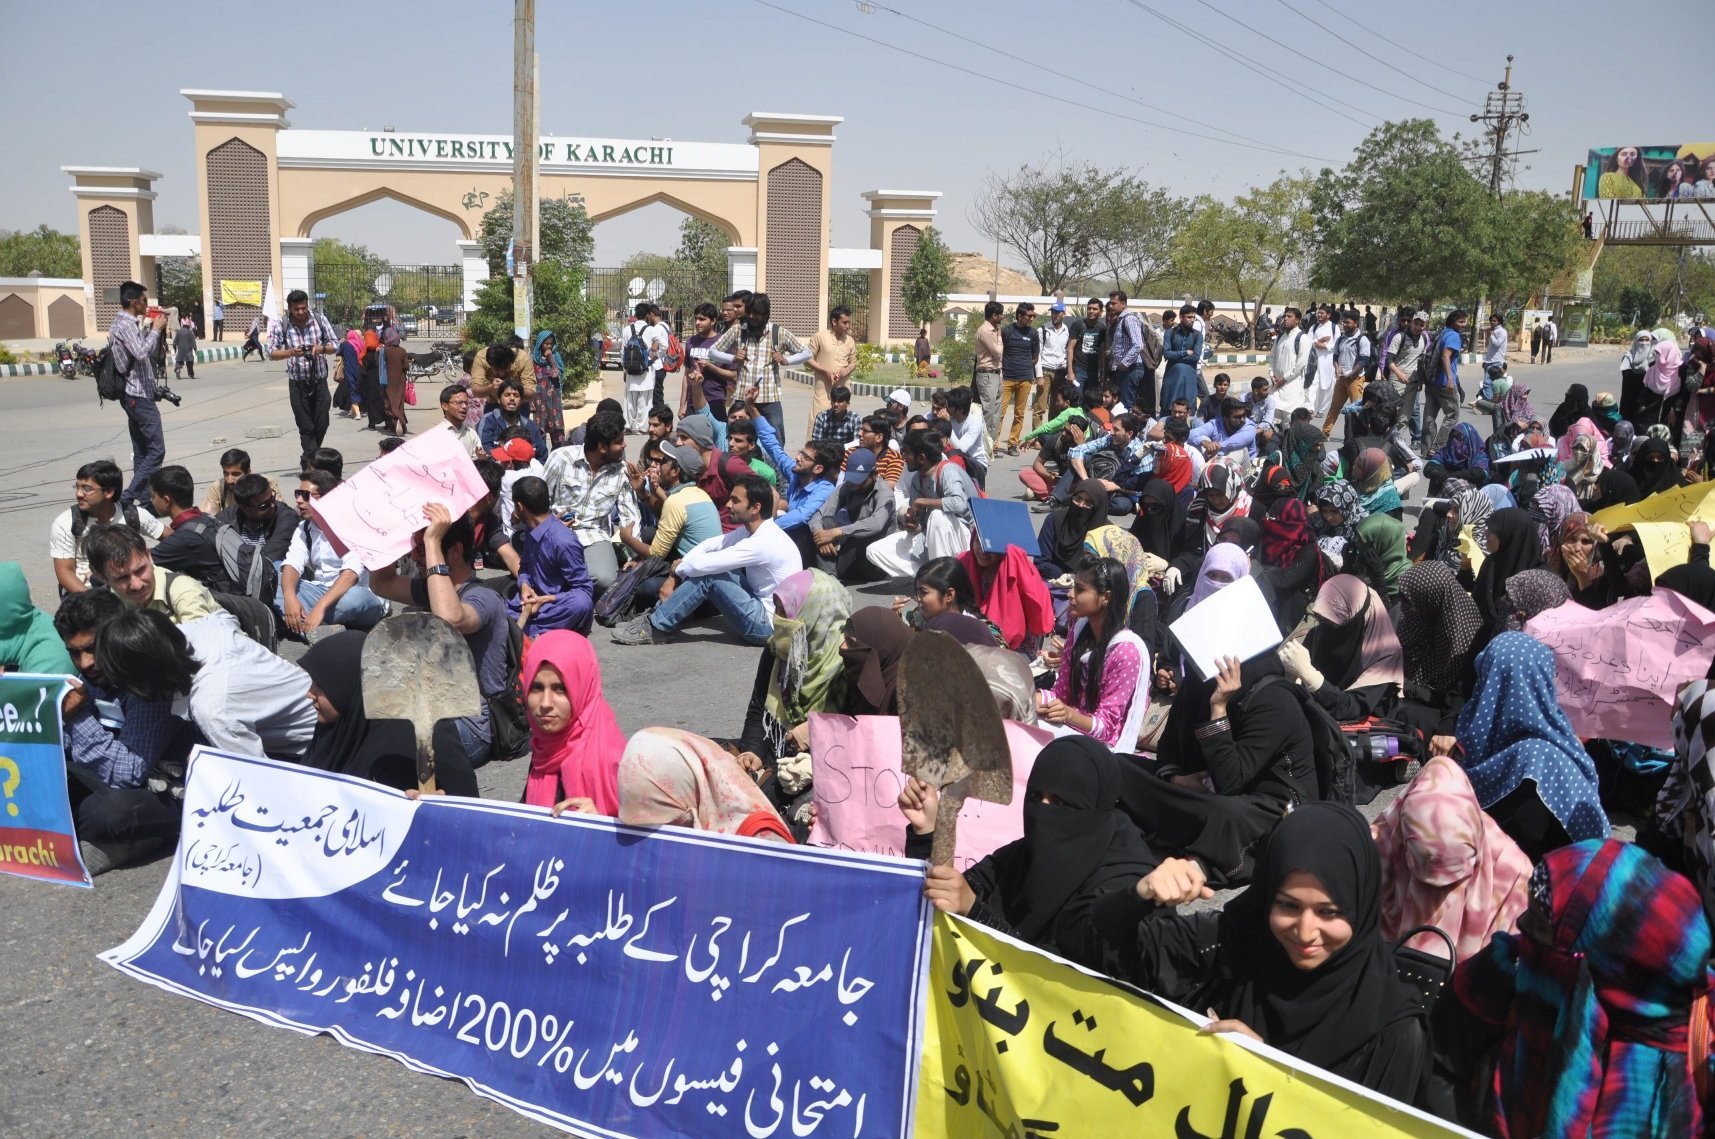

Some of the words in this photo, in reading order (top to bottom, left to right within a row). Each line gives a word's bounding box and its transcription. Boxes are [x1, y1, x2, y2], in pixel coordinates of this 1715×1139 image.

[370, 138, 514, 159] UNIVERSITY
[538, 143, 554, 161] F
[566, 144, 673, 165] KARACHI
[191, 777, 245, 828] طلبہ
[816, 744, 908, 810] STO
[231, 804, 339, 846] جمعیت
[323, 808, 386, 857] اسلامی
[382, 859, 455, 931] جائے
[452, 863, 506, 936] کیا
[477, 891, 511, 926] نہ
[504, 856, 565, 957] ظلم
[567, 889, 633, 966] طلبہ
[235, 931, 323, 990] واپس
[536, 908, 569, 965] پر
[623, 896, 679, 962] کے
[685, 912, 811, 1002] کراچی
[375, 969, 462, 1029] اضافہ
[771, 946, 876, 1027] جامعہ
[456, 994, 575, 1073] 200%
[573, 1029, 640, 1090] میں
[1043, 1009, 1154, 1107] مت
[629, 1038, 748, 1117] فیسوں
[744, 1041, 867, 1139] امتحانی
[1175, 1077, 1315, 1139] ال
